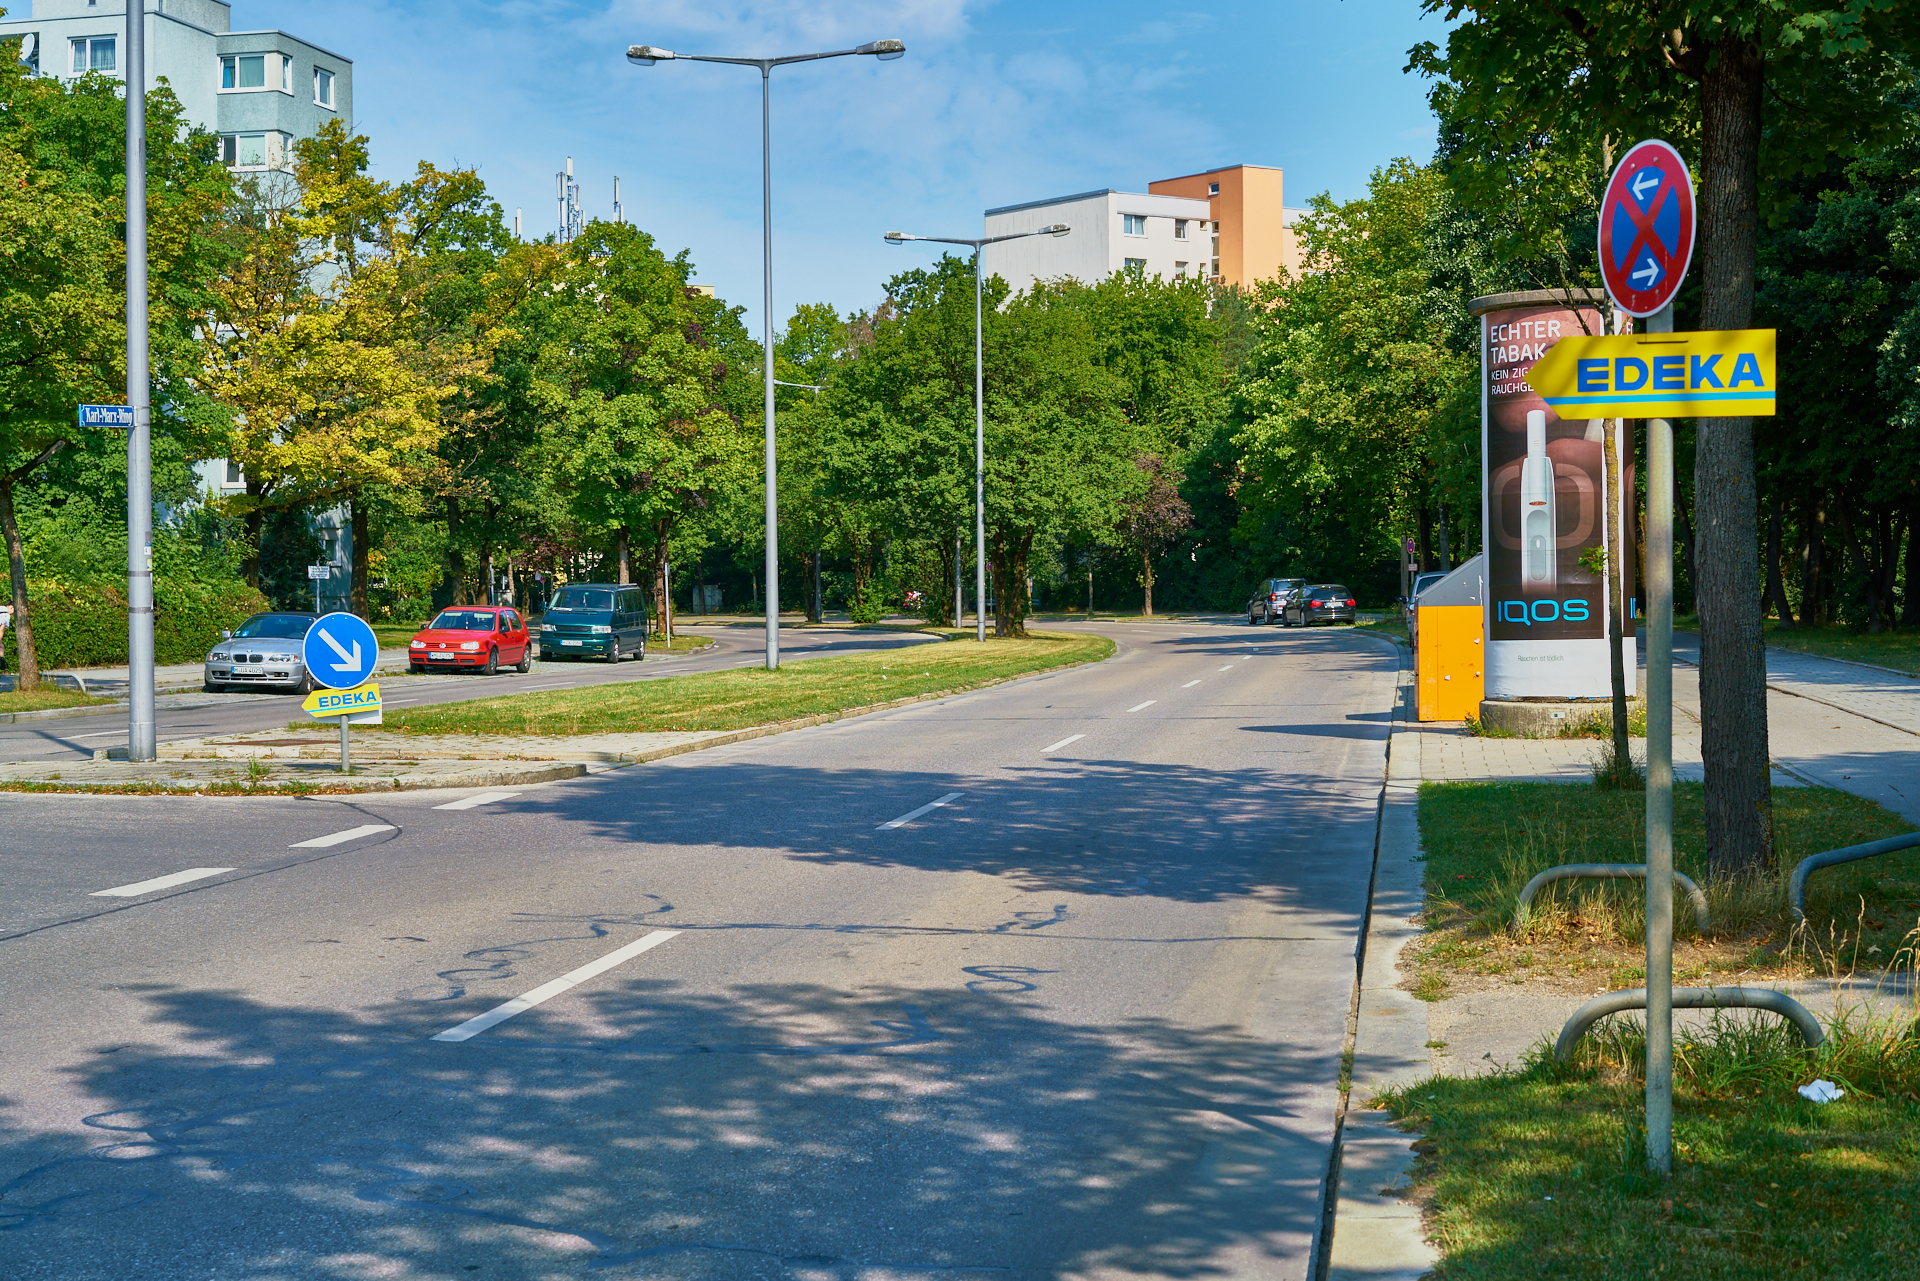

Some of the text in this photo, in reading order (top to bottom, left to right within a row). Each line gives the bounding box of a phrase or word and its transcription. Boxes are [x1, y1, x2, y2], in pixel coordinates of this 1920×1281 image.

[1490, 320, 1561, 343] ECHTER
[1490, 342, 1547, 364] TABAK
[1491, 367, 1533, 381] KEIN ZIG
[1577, 353, 1765, 393] EDEKA
[85, 407, 132, 426] Karl-Marx-Ring
[1498, 598, 1590, 626] IQOS
[318, 690, 377, 708] EDEKA
